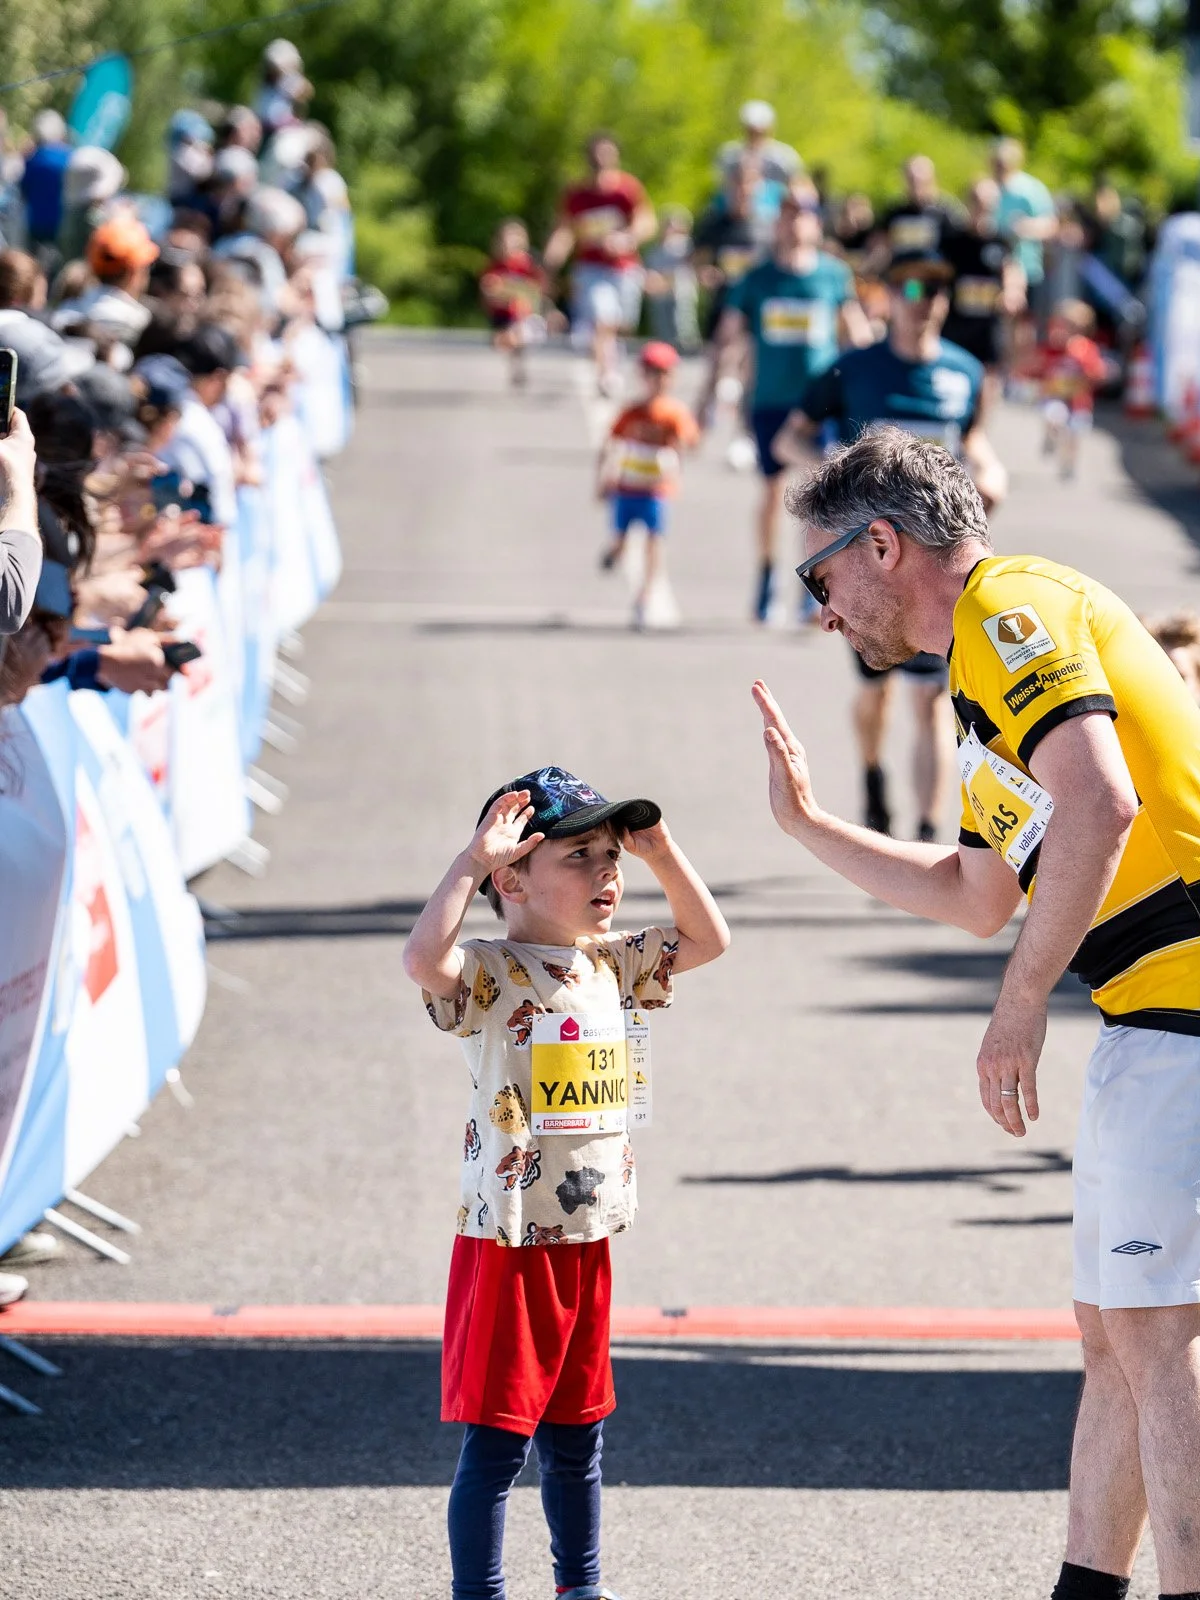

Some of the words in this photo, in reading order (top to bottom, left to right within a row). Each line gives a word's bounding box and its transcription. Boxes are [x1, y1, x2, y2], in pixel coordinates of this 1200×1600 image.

[1006, 648, 1031, 666] Schweizer
[1031, 640, 1051, 650] Meister
[1008, 662, 1083, 709] Weiss+Appetito
[996, 765, 1006, 777] 131
[1018, 822, 1042, 852] valiant
[587, 1048, 615, 1071] 131
